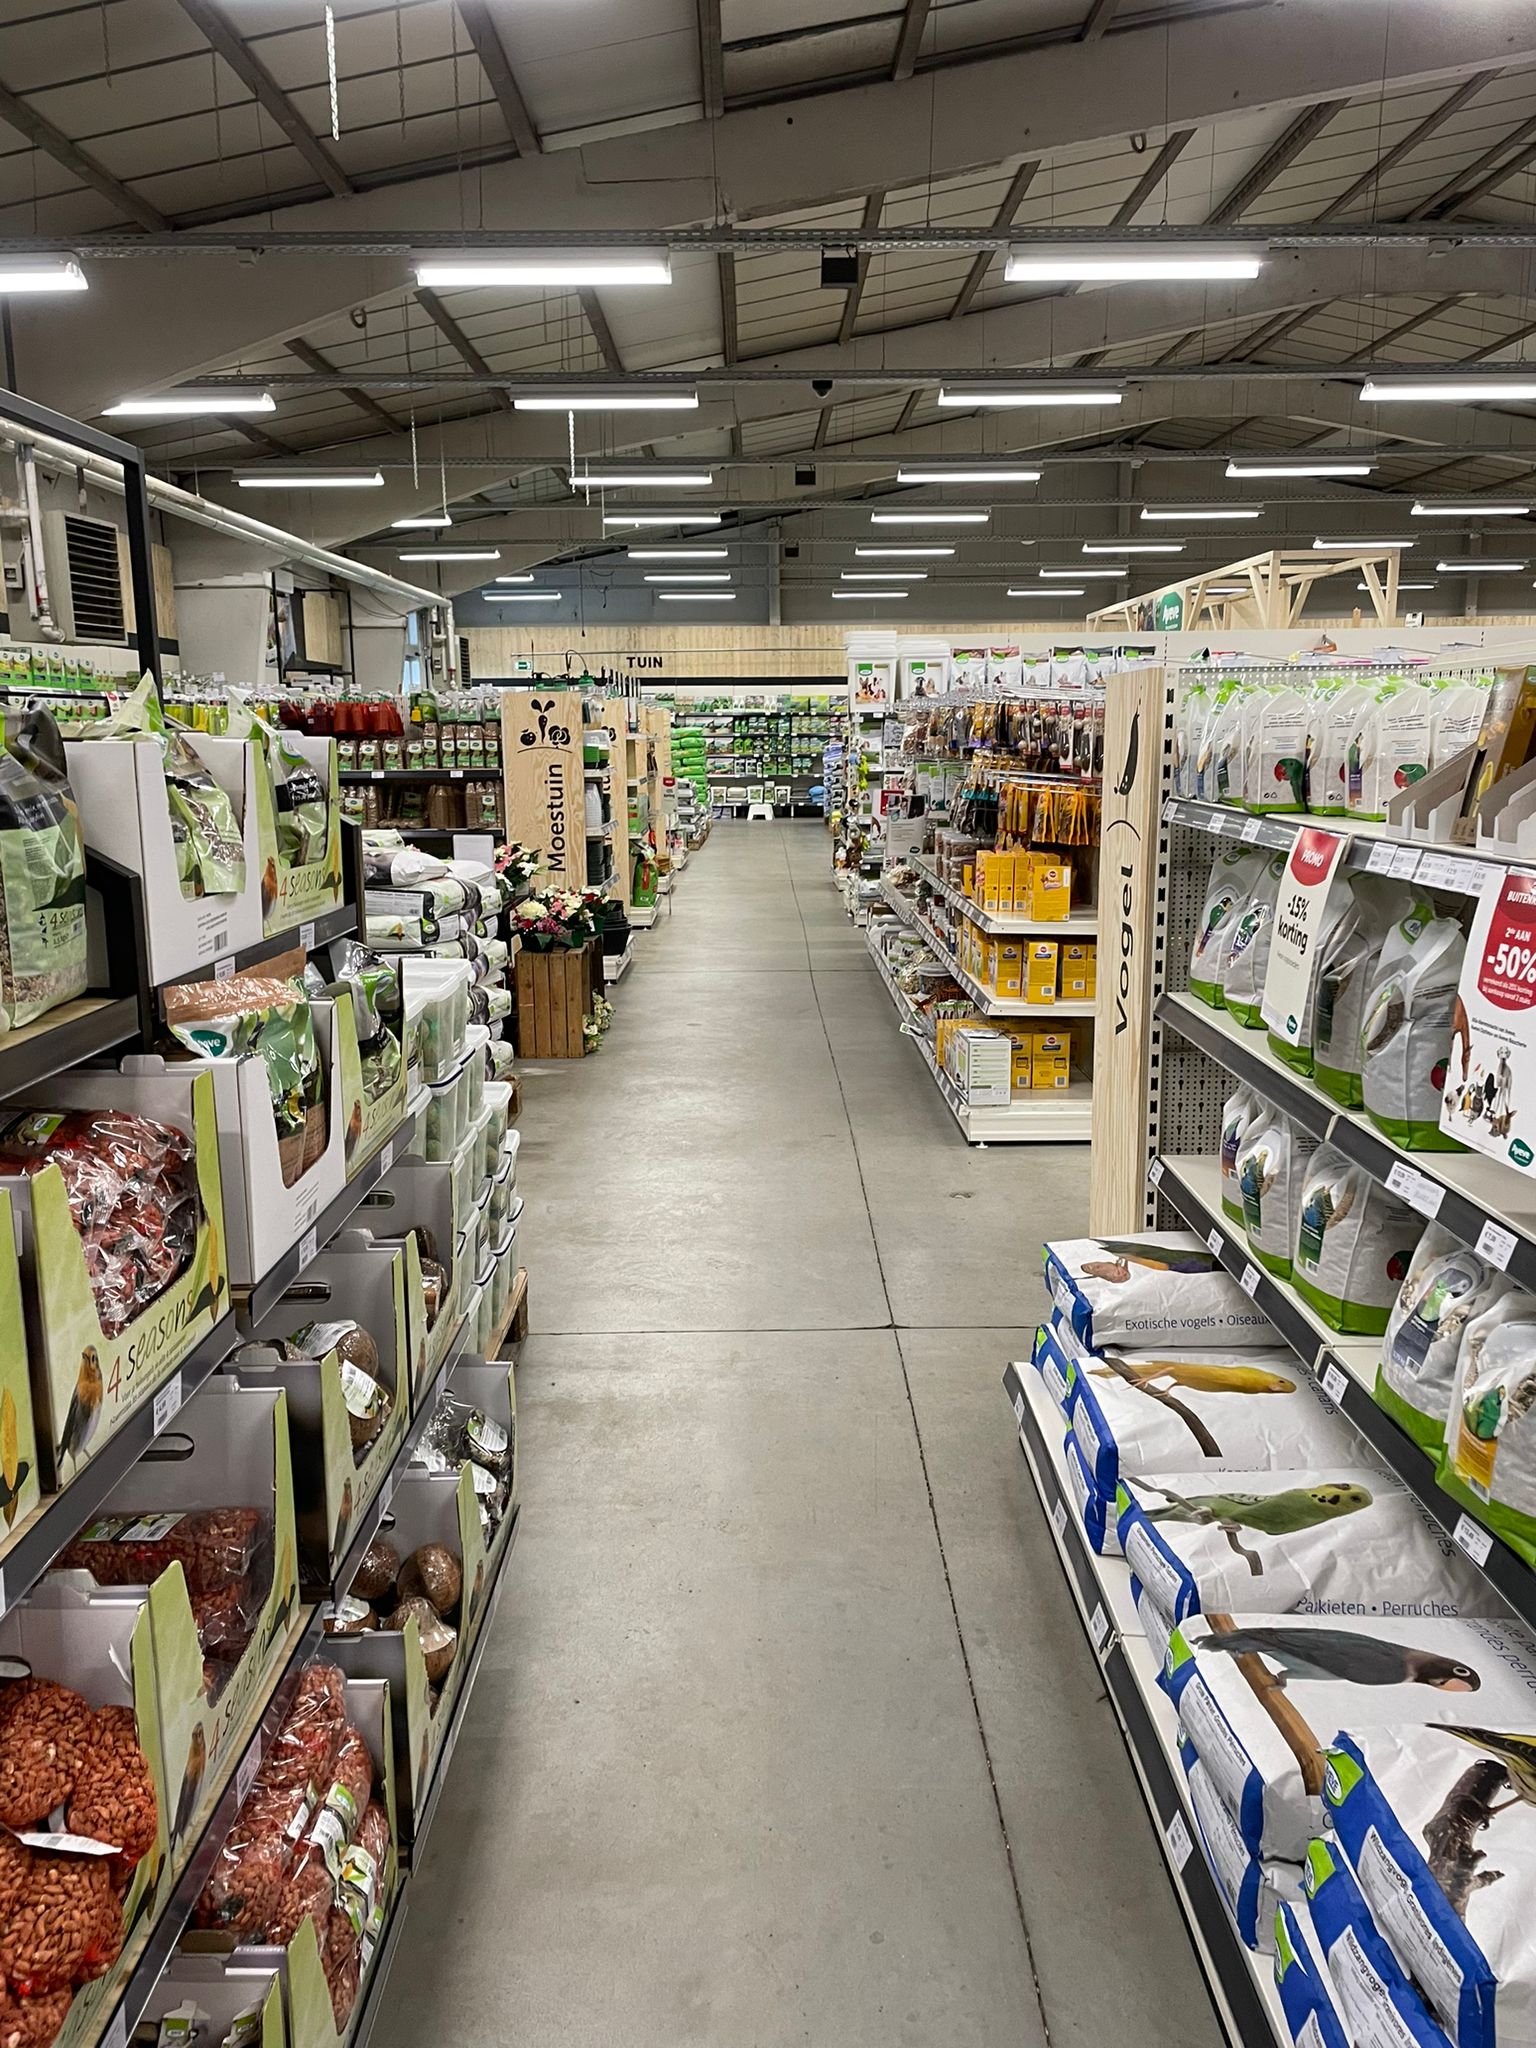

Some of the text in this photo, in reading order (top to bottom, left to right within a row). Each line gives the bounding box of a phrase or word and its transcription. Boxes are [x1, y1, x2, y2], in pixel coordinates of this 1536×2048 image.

[626, 656, 663, 669] TUIN
[545, 763, 566, 873] Moestuin
[1300, 849, 1325, 868] PROMO
[1287, 894, 1310, 922] -15%
[1115, 864, 1134, 1036] Vogel
[1277, 915, 1309, 955] korting
[1486, 943, 1536, 984] -50%
[1125, 1317, 1177, 1330] Exotische
[1179, 1317, 1216, 1329] vogels
[107, 1355, 121, 1403] 4
[126, 1289, 194, 1381] seasons
[1382, 1600, 1459, 1616] Perruches
